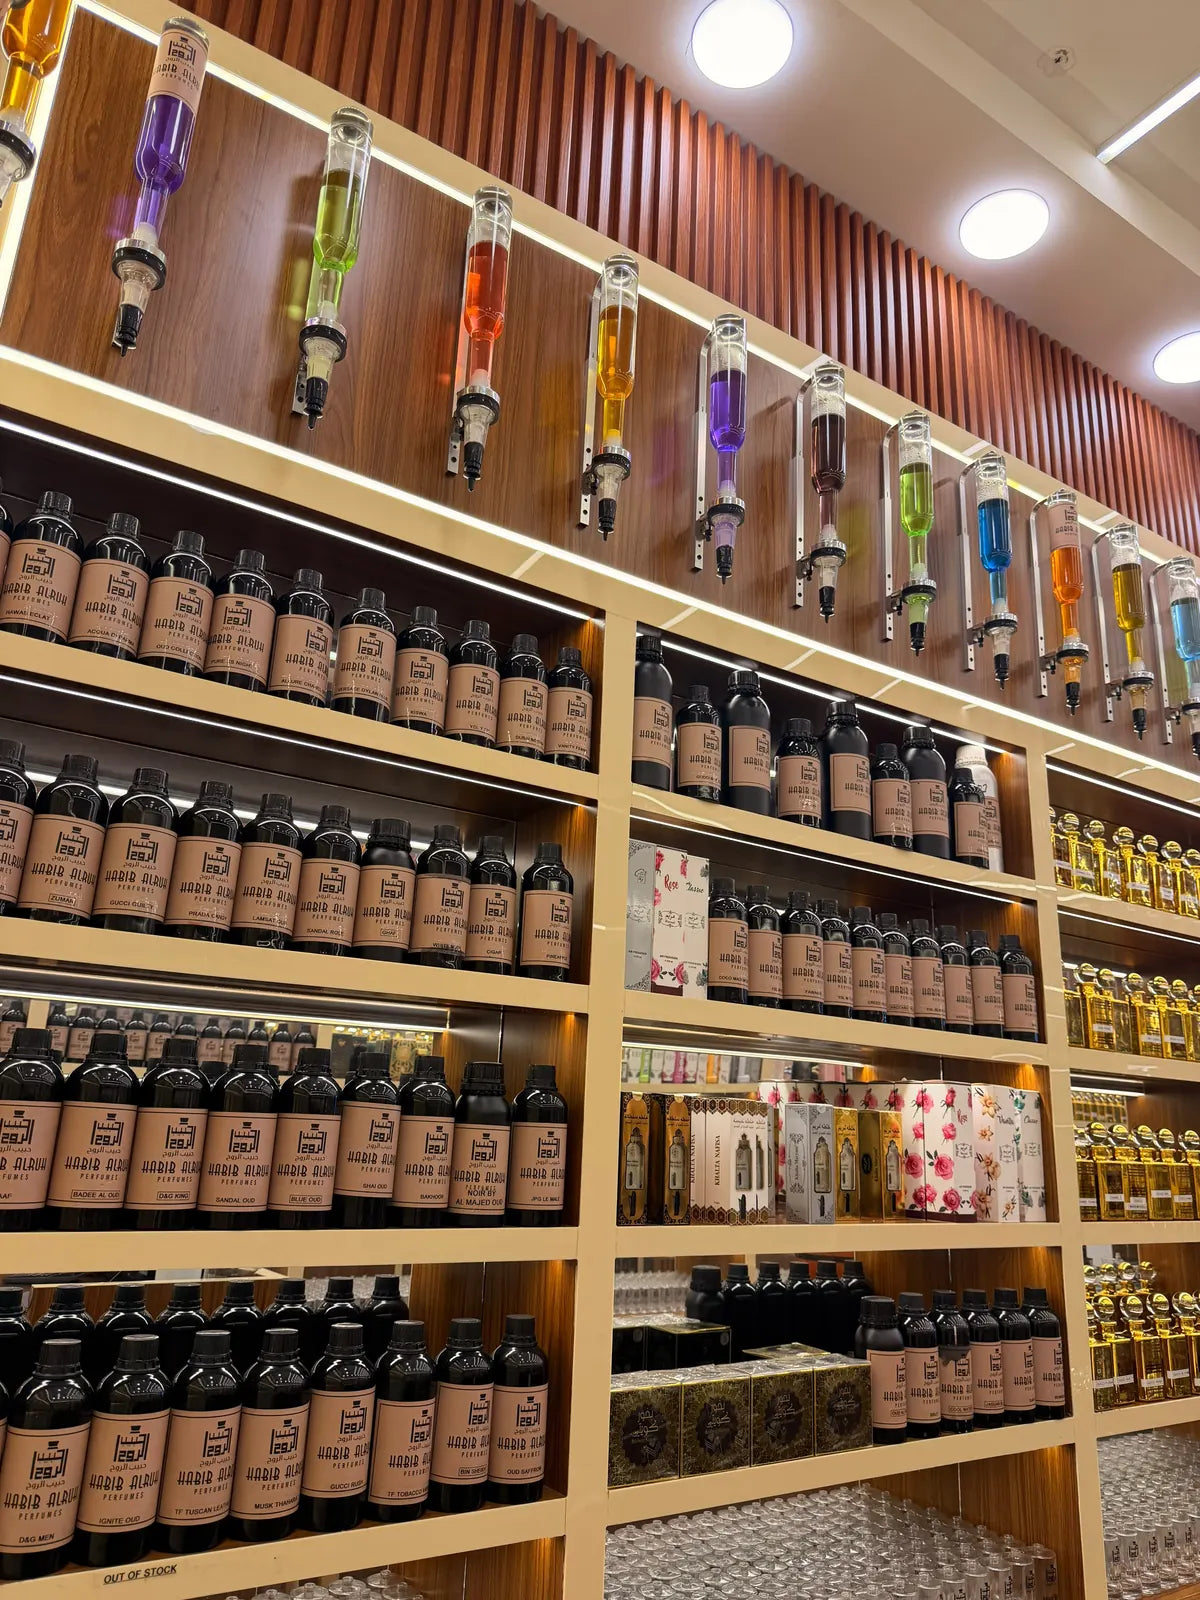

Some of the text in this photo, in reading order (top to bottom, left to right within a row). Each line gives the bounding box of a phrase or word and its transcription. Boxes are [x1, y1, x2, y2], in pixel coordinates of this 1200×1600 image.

[36, 585, 68, 606] ALRUH
[85, 602, 117, 615] HABIB
[154, 618, 185, 632] HABIB
[237, 635, 265, 652] ALRUH
[286, 653, 315, 668] HABIB
[341, 662, 367, 672] HABIB
[395, 686, 419, 697] HABIB
[456, 699, 481, 710] HABIB
[508, 712, 532, 723] HABIB
[552, 722, 576, 733] HABIB
[31, 862, 97, 886] HABIB ALRUH
[105, 869, 168, 889] HABIB ALRUH
[44, 877, 82, 890] PERFUMES
[117, 884, 154, 894] PERFUMES
[180, 882, 212, 895] HABIB
[243, 886, 273, 899] HABIB
[300, 901, 328, 913] HABIB
[362, 907, 391, 917] HABIB
[188, 910, 210, 919] PRADA
[423, 914, 450, 926] HABIB
[468, 923, 494, 935] HABIB
[534, 929, 560, 940] HABIB
[720, 953, 742, 964] HABIB
[792, 967, 815, 978] HABIB
[64, 1156, 101, 1171] HABIB
[347, 1150, 378, 1165] HABIB
[12, 1157, 47, 1171] ALRUH
[141, 1160, 176, 1174] HABIB
[208, 1163, 270, 1177] HABIB ALRUH
[276, 1163, 308, 1177] HABIB
[404, 1163, 434, 1177] HABIB
[80, 1173, 119, 1181] PERFUMES
[454, 1170, 481, 1182] HABIB
[519, 1167, 547, 1179] HABIB
[941, 1383, 964, 1394] HABIB
[977, 1378, 998, 1389] HABIB
[910, 1387, 933, 1399] HABIB
[447, 1435, 477, 1450] HABIB
[497, 1436, 526, 1450] HABIB
[317, 1446, 350, 1460] HABIB
[388, 1454, 419, 1469] HABIB
[177, 1470, 213, 1486] HABIB
[246, 1467, 280, 1481] HABIB
[89, 1470, 159, 1491] HABIB ALRUH
[262, 1480, 296, 1491] PERFUMES
[4, 1486, 79, 1510] HABIB ALRUH
[103, 1492, 144, 1501] PERFUMES
[397, 1489, 423, 1497] TOBACCO
[19, 1509, 62, 1520] PERFUMES
[185, 1506, 212, 1515] TUSCAN
[125, 1515, 140, 1523] OUD
[38, 1533, 55, 1541] MEN
[103, 1564, 178, 1585] OUT OF STOCK
